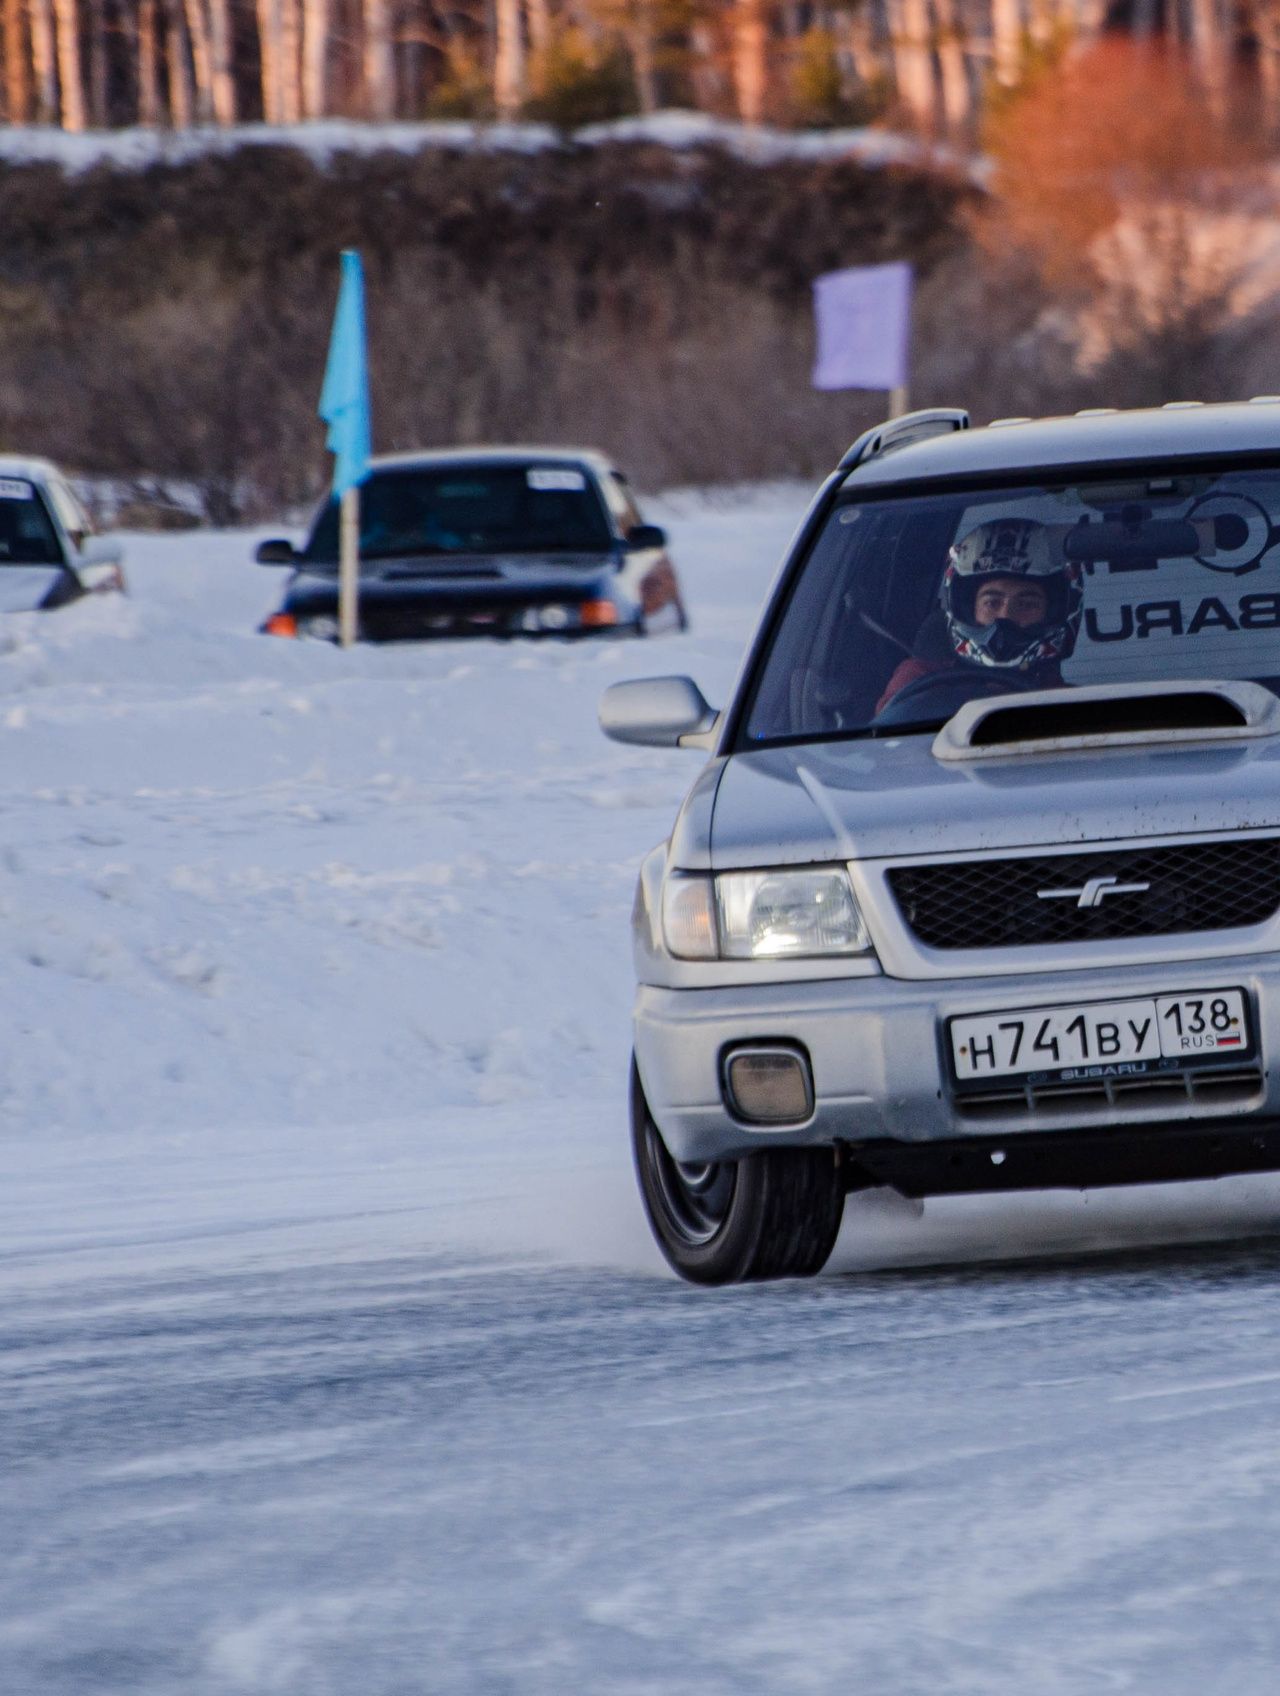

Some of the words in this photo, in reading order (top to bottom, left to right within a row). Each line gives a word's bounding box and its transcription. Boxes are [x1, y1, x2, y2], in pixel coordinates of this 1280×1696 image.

[1164, 998, 1232, 1036] 138
[1180, 1034, 1216, 1050] RUS
[1060, 1061, 1148, 1081] SUBARU
